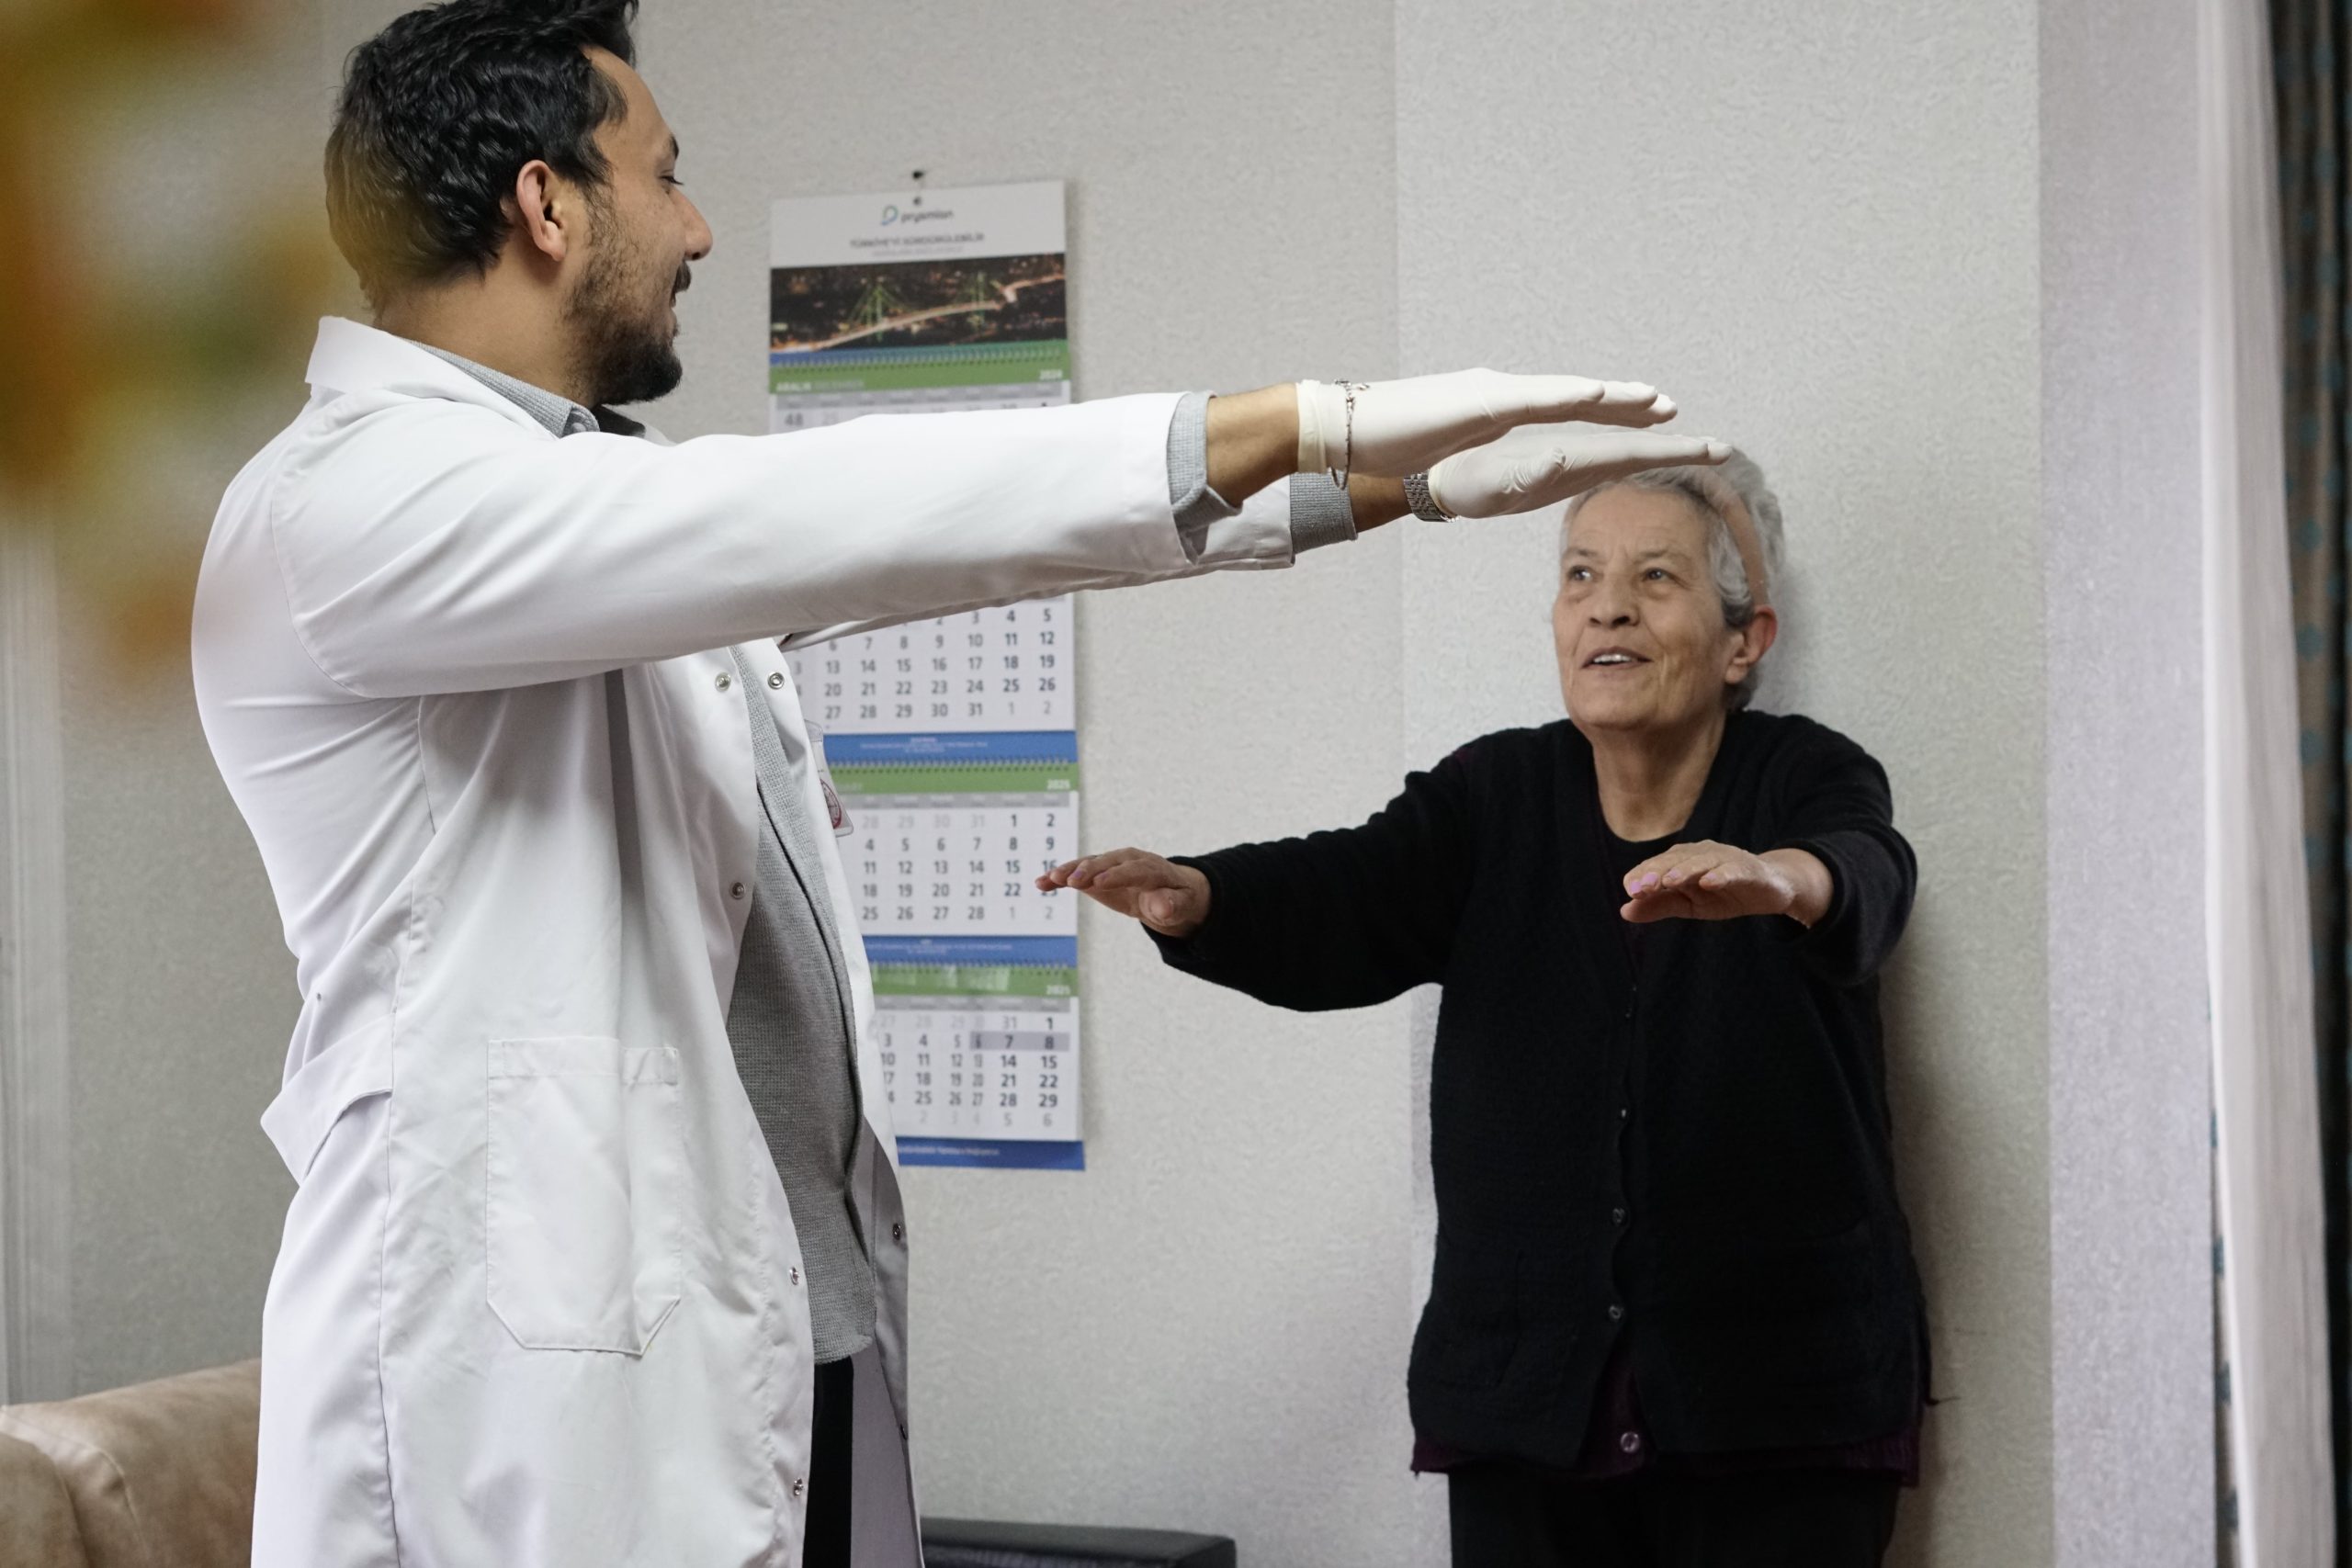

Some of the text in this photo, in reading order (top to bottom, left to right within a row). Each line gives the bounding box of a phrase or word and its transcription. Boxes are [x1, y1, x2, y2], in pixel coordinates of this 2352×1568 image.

[785, 412, 804, 426] 48
[1006, 609, 1017, 624] 4
[1043, 607, 1052, 623] 5
[865, 637, 874, 650] 7
[899, 635, 909, 650] 8
[934, 634, 944, 649] 9
[967, 633, 984, 649] 10
[1004, 632, 1019, 647] 11
[1039, 630, 1056, 646] 12
[825, 660, 842, 675] 13
[860, 659, 877, 674] 14
[896, 658, 912, 673] 15
[931, 657, 948, 672] 16
[967, 655, 984, 671] 17
[1002, 654, 1020, 671] 18
[1039, 653, 1057, 670] 19
[824, 682, 842, 698] 20
[860, 681, 876, 697] 21
[895, 680, 912, 696] 22
[931, 679, 948, 695] 23
[966, 678, 985, 694] 24
[1002, 677, 1021, 694] 25
[1038, 676, 1057, 693] 26
[824, 700, 1052, 720] 27 28 29 30 31 1 2
[1010, 812, 1018, 829] 1
[1046, 812, 1057, 829] 2
[865, 835, 1056, 852] 4 5 6 7 8 9
[863, 860, 877, 875] 11
[898, 860, 913, 875] 12
[933, 859, 949, 875] 13
[968, 860, 986, 875] 14
[1004, 859, 1022, 875] 15
[862, 883, 878, 898] 18
[898, 883, 914, 898] 19
[932, 882, 951, 898] 20
[968, 882, 985, 898] 21
[1003, 882, 1022, 898] 22
[861, 905, 1054, 921] 25 26 27 28 1 2
[1002, 1016, 1018, 1032] 31
[1046, 1016, 1055, 1032] 1
[884, 1032, 893, 1048] 3
[919, 1032, 929, 1048] 4
[953, 1033, 961, 1049] 5
[1004, 1034, 1014, 1050] 7
[1044, 1035, 1055, 1051] 8
[880, 1051, 897, 1067] 10
[916, 1052, 931, 1067] 11
[950, 1053, 964, 1068] 12
[1001, 1055, 1018, 1069] 14
[1040, 1055, 1058, 1070] 15
[915, 1071, 932, 1087] 18
[950, 1072, 963, 1088] 19
[1001, 1073, 1017, 1089] 21
[1038, 1073, 1059, 1089] 22
[914, 1089, 933, 1106] 25
[948, 1090, 962, 1107] 26
[971, 1091, 984, 1107] 27
[999, 1092, 1018, 1108] 28
[1037, 1092, 1059, 1109] 29
[1002, 1111, 1012, 1127] 5
[1043, 1111, 1053, 1128] 6
